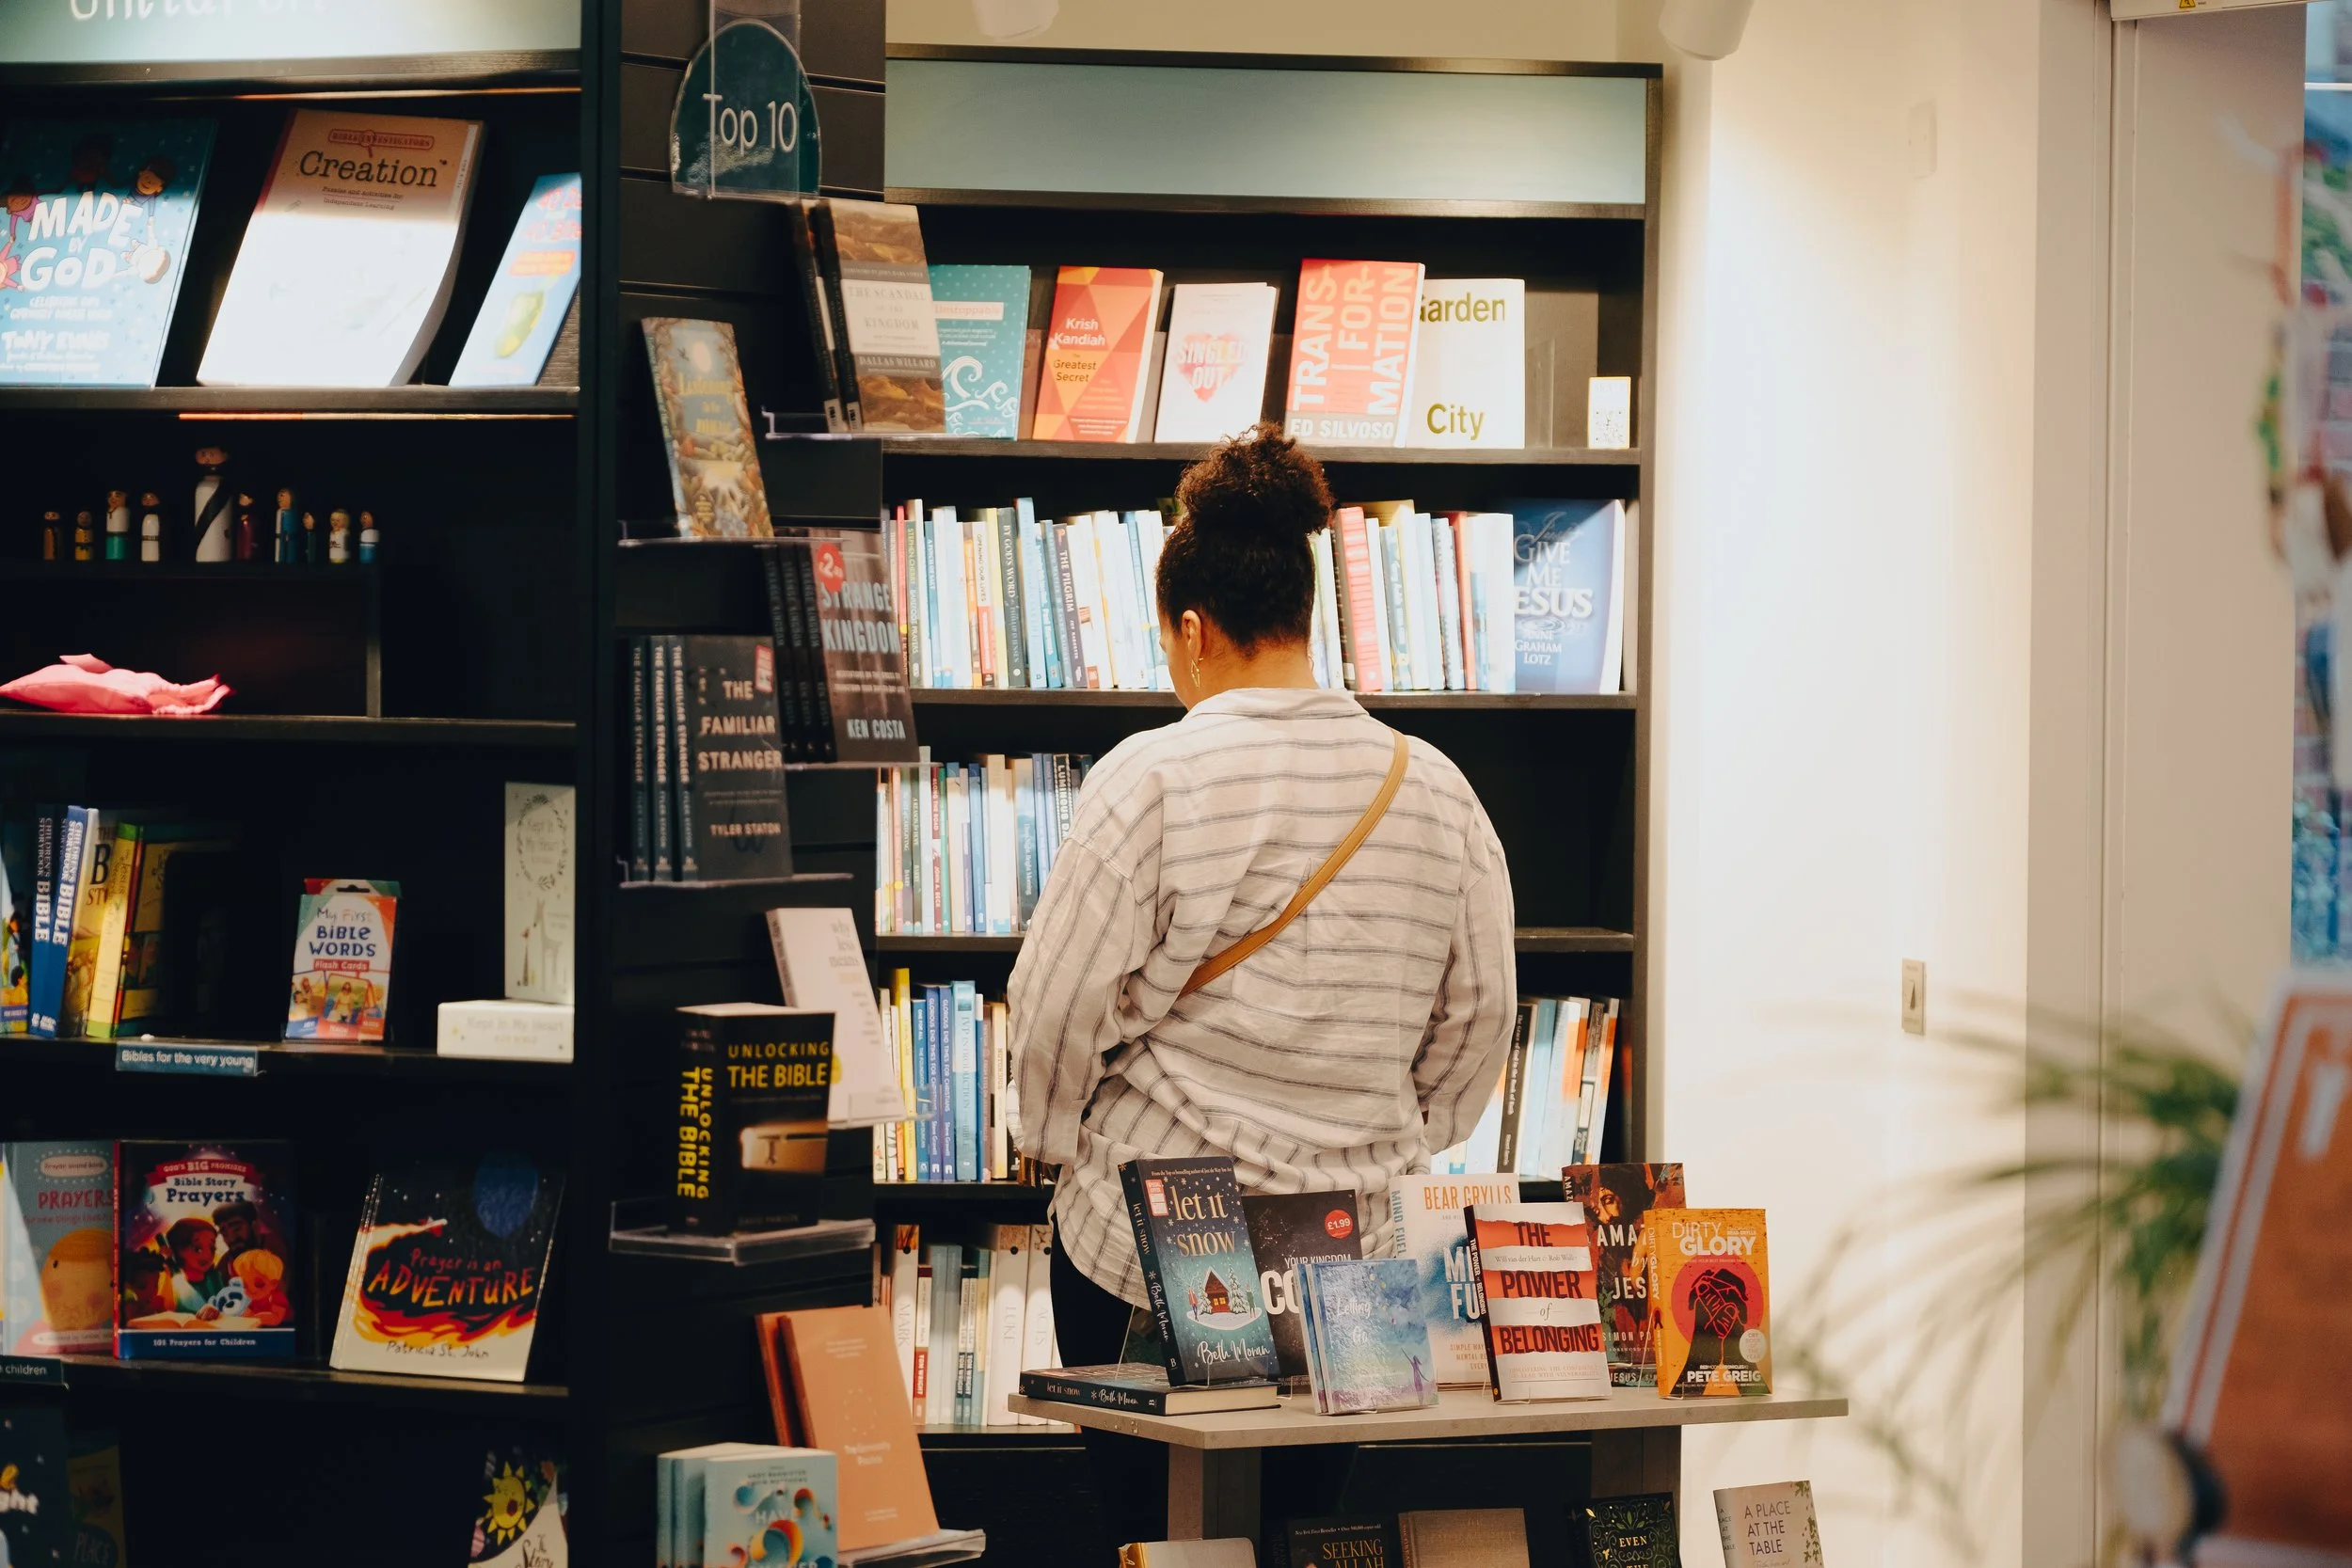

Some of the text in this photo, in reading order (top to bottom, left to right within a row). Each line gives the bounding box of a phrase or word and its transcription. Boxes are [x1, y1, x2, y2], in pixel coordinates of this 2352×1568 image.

[703, 93, 797, 156] Top 10
[300, 150, 437, 186] Creation
[365, 200, 395, 211] Learning
[28, 190, 143, 247] MADE
[68, 237, 88, 253] BY
[849, 286, 927, 301] THE SCANDAL
[865, 318, 919, 331] KINGDOM
[1065, 318, 1099, 330] Krish
[1054, 333, 1106, 346] Kandiah
[1367, 267, 1416, 416] MATION
[858, 356, 937, 368] DALLAS WILLARD
[1178, 341, 1248, 365] SINGLED
[1053, 359, 1097, 371] Greatest
[1056, 372, 1089, 383] Secret
[1192, 366, 1225, 389] OUT
[1290, 419, 1395, 439] ED SILVOSO
[1426, 403, 1485, 440] City
[1514, 533, 1571, 564] GIVE
[1004, 524, 1016, 598] BY GOD'S WORD
[1059, 549, 1075, 612] THE PILGRIM
[1514, 587, 1594, 618] ESUS
[821, 619, 901, 654] KINGDOM
[1515, 641, 1563, 653] GRAHAM
[1523, 653, 1552, 665] LOTZ
[723, 680, 754, 700] THE
[633, 646, 644, 783] THE FAMILIAR STRANGER
[655, 645, 666, 784] THE FAMILIAR STRANGER
[672, 645, 690, 784] THE FAMILIAR STRANGER
[700, 716, 776, 735] FAMILIAR
[848, 719, 907, 739] KEN COSTA
[697, 751, 783, 771] STRANGER
[1058, 765, 1069, 820] LUMINOUS
[710, 823, 782, 835] TYLER STATON
[37, 817, 45, 876] STORYBOOK
[60, 819, 77, 881] STORYBOOK
[68, 821, 84, 886] CHILDREN'S
[35, 880, 51, 942] BIBLE
[53, 883, 75, 946] BIBLE
[316, 908, 373, 925] My First
[309, 942, 376, 957] WORDS
[314, 960, 368, 970] Flash Cards
[121, 1050, 255, 1069] Bibles for the very young
[728, 1041, 830, 1059] UNLOCKING
[961, 1017, 973, 1109] IVP INTRODUCTION
[727, 1063, 828, 1088] THE BIBLE
[677, 1067, 700, 1198] THE BIBLE
[697, 1068, 713, 1199] UNLOCKING
[163, 1161, 246, 1173] GOD'S BIG PROMISES
[174, 1177, 236, 1188] Bible Story
[38, 1190, 114, 1210] PRAYERS
[167, 1188, 246, 1207] Prayers
[1169, 1185, 1229, 1221] let it
[1423, 1184, 1513, 1211] BEAR GRYLLS
[1133, 1202, 1151, 1255] let it snow
[1327, 1217, 1351, 1231] £1.99
[1391, 1191, 1406, 1257] MIND FUEL
[1514, 1222, 1553, 1247] THE
[1672, 1222, 1723, 1240] DIRTY
[1177, 1230, 1236, 1258] snow
[1679, 1235, 1756, 1257] GLORY
[409, 1247, 502, 1273] Prayer is an
[1284, 1253, 1352, 1268] YOUR KINGDOM
[367, 1259, 535, 1308] ADVENTURE
[1471, 1252, 1481, 1276] POWER
[1476, 1282, 1486, 1315] BELONGING
[1501, 1270, 1583, 1299] POWER
[1151, 1281, 1170, 1342] Beth Moran
[1336, 1295, 1373, 1319] Letting
[1540, 1303, 1553, 1321] of
[898, 1304, 912, 1348] MARK
[1003, 1306, 1017, 1345] LUKE
[1036, 1307, 1049, 1347] ACTS
[1601, 1331, 1634, 1342] SIMON
[169, 1338, 201, 1348] Prayers
[204, 1338, 216, 1347] for
[220, 1338, 257, 1347] Children
[386, 1340, 489, 1359] Patricia St. John
[1450, 1343, 1472, 1352] SIMPLE
[1499, 1325, 1599, 1354] BELONGING
[1169, 1357, 1177, 1368] B
[1197, 1338, 1271, 1365] Beth Moran
[5, 1365, 46, 1375] children
[1687, 1370, 1762, 1383] PETE GREIG
[1046, 1382, 1081, 1396] let it snow
[1098, 1388, 1138, 1406] Beth Moran
[1744, 1500, 1791, 1520] A PLACE
[1748, 1521, 1786, 1538] AT THE
[1323, 1538, 1383, 1560] SEEKING
[1619, 1535, 1647, 1548] EVEN
[1749, 1539, 1783, 1556] TABLE
